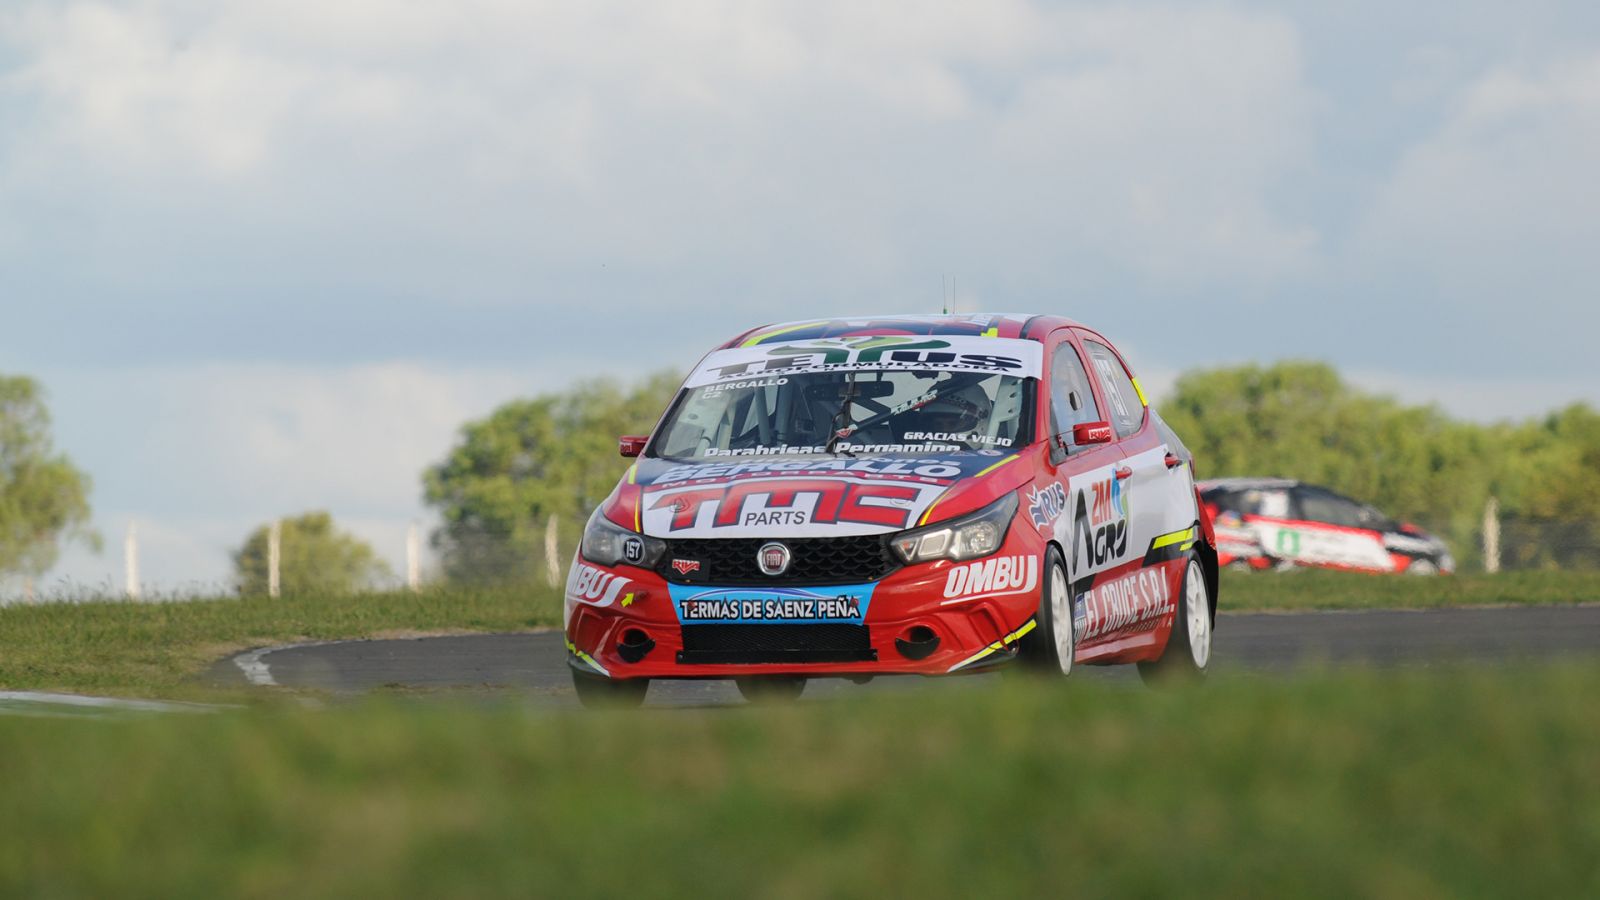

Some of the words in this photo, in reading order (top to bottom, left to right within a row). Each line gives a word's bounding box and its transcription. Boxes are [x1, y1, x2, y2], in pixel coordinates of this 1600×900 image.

[717, 361, 1009, 379] AGROFORMULADORA
[705, 378, 788, 393] BERGALLO
[904, 431, 966, 442] GRACIAS
[972, 434, 1012, 447] VIEJO
[651, 461, 961, 485] BERGALLO
[662, 470, 938, 488] MOTORPARTS
[648, 479, 923, 532] TMC
[744, 510, 806, 526] PARTS
[626, 541, 641, 559] 157
[672, 558, 700, 574] RIVA
[766, 553, 781, 566] FIAT
[943, 555, 1025, 598] OMBU
[681, 601, 739, 618] TERMAS
[742, 602, 762, 618] DE
[765, 601, 815, 618] SAENZ
[818, 597, 860, 618] PEÑA
[1083, 589, 1100, 640] EL
[1101, 575, 1138, 634] CRUCE
